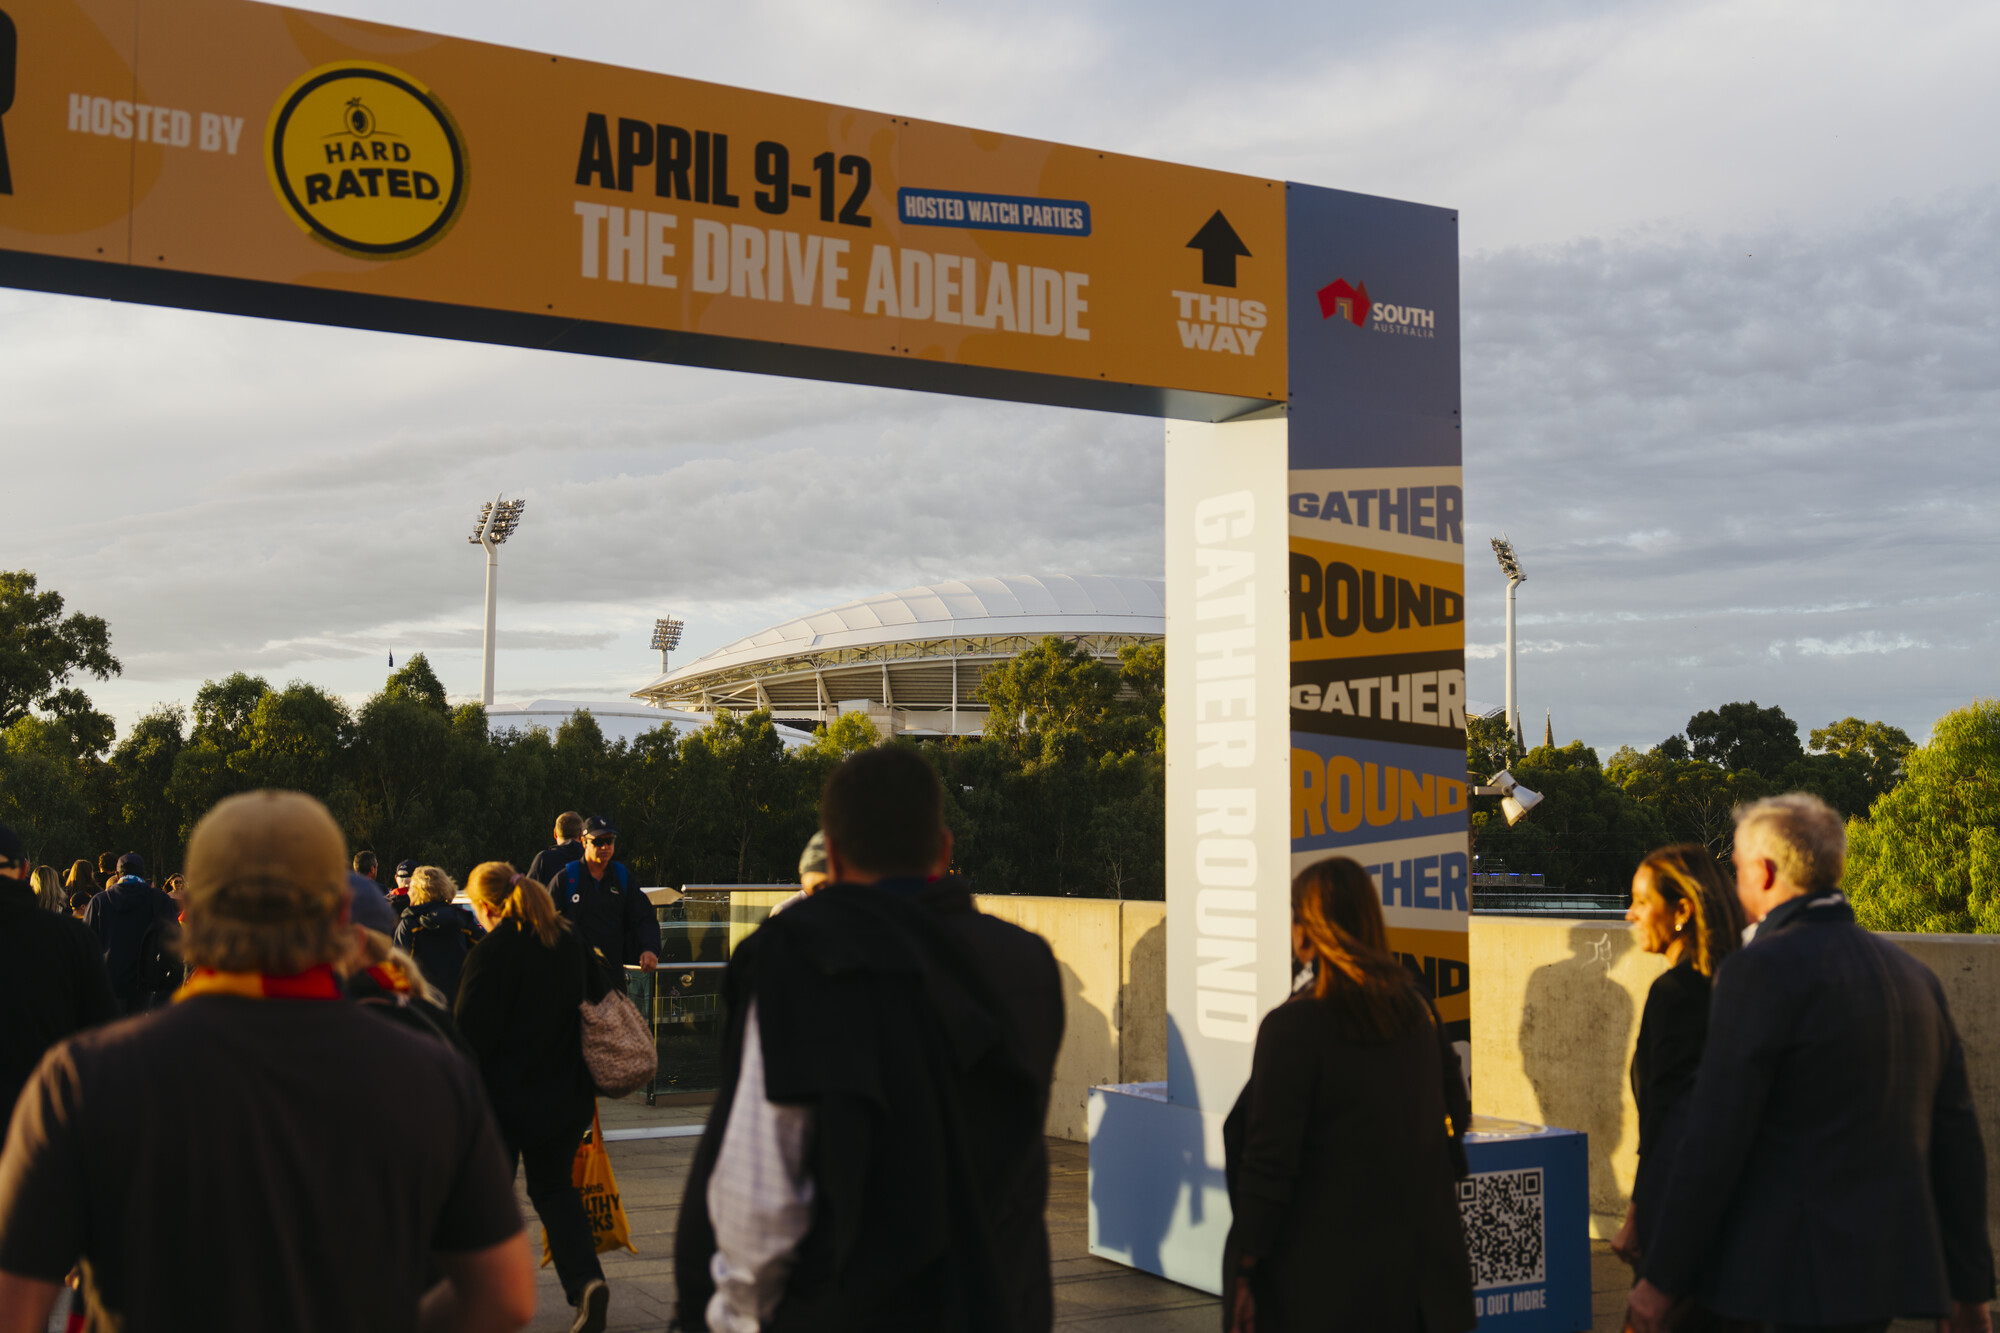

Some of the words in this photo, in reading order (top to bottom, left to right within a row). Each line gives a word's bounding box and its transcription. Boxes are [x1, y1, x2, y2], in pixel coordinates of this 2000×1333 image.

[68, 94, 191, 148] HOSTED
[199, 111, 244, 156] BY
[324, 141, 411, 164] HARD
[574, 112, 740, 208] APRIL
[753, 140, 872, 228] 9-12
[904, 195, 965, 222] HOSTED
[968, 200, 1020, 226] WATCH
[1022, 203, 1084, 230] PARTIES
[573, 201, 678, 289] THE
[692, 218, 851, 311] DRIVE
[863, 244, 1091, 342] ADELAIDE
[1171, 290, 1267, 328] THIS
[1176, 320, 1263, 356] WAY
[1372, 302, 1435, 329] SOUTH
[1373, 323, 1435, 339] AUSTRALIA
[1289, 484, 1464, 545] GATHER
[1289, 550, 1465, 641] ROUND
[1195, 489, 1256, 770] GATHER
[1290, 668, 1466, 730] GATHER
[1290, 747, 1468, 839] ROUND
[1195, 787, 1257, 1044] ROUND
[1486, 1293, 1511, 1317] OUT
[1512, 1288, 1547, 1313] MORE
